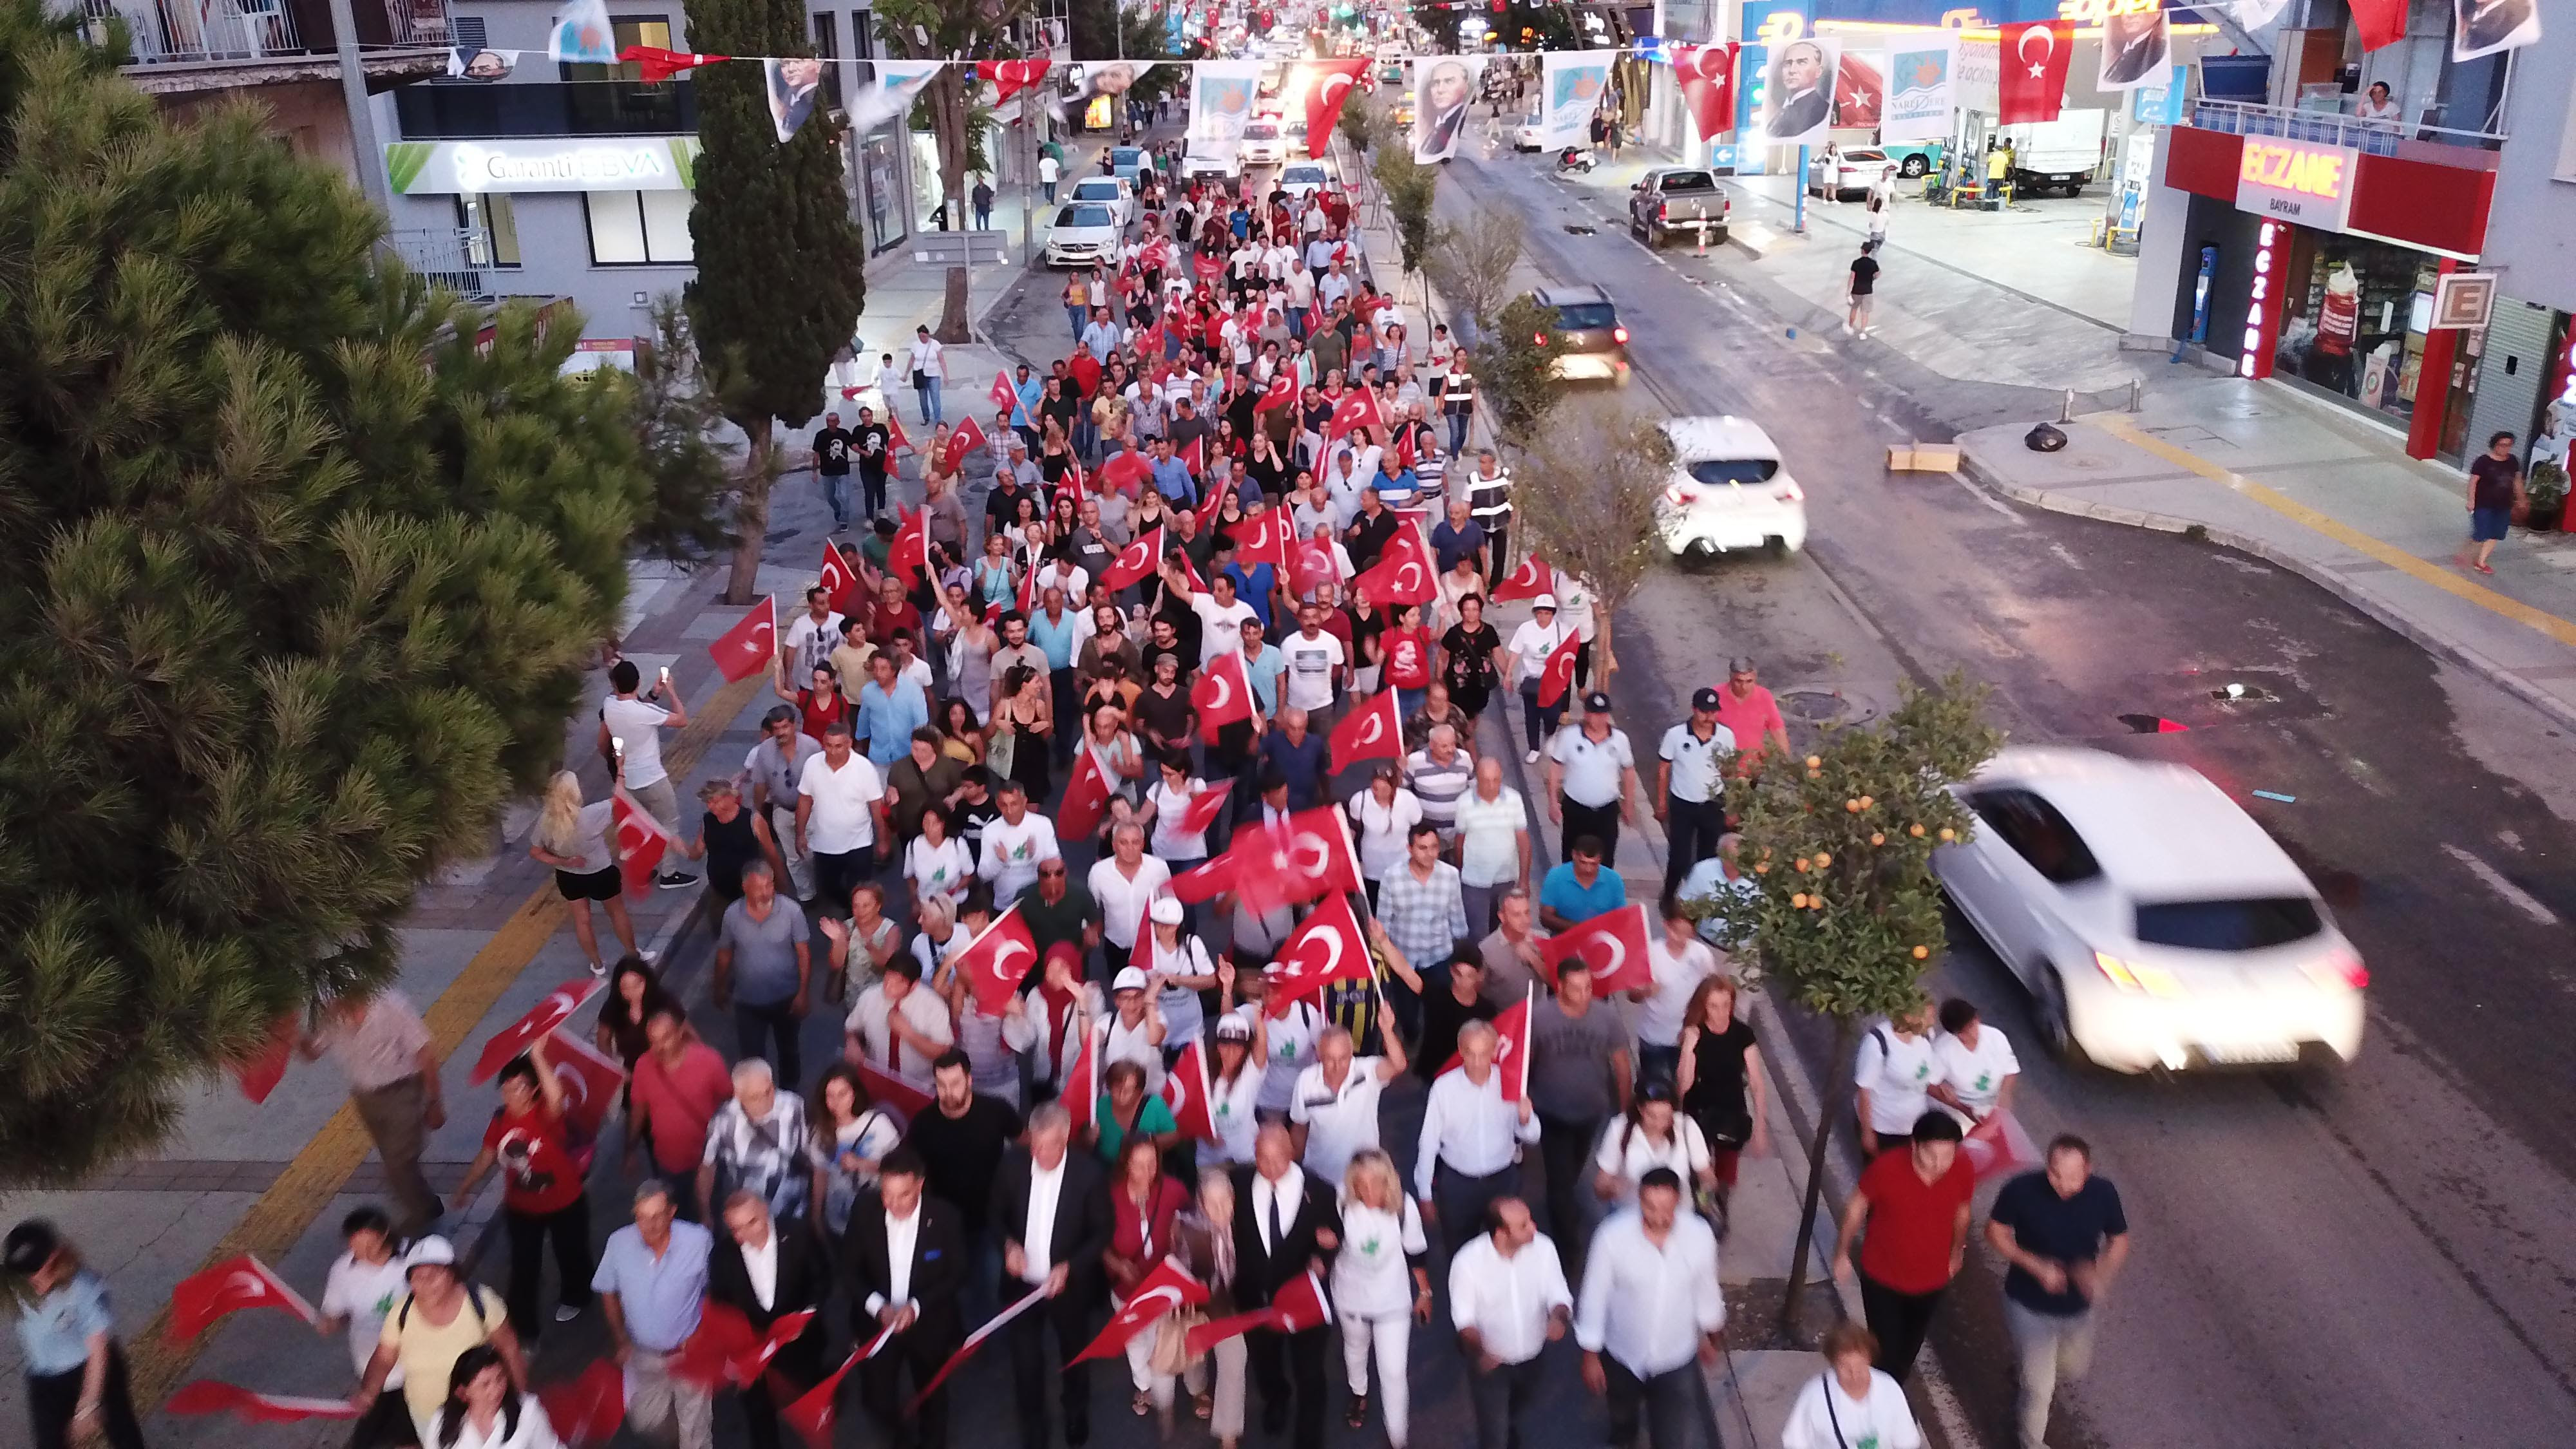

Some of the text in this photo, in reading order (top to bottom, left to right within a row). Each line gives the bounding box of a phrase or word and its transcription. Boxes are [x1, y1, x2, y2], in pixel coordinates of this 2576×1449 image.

[487, 152, 660, 178] Garanti BBVA
[2242, 143, 2344, 198] ECZANE
[2270, 197, 2301, 216] BAYRAM
[2241, 223, 2275, 377] ECZANE
[2450, 285, 2481, 317] E
[1082, 544, 1105, 554] VANS
